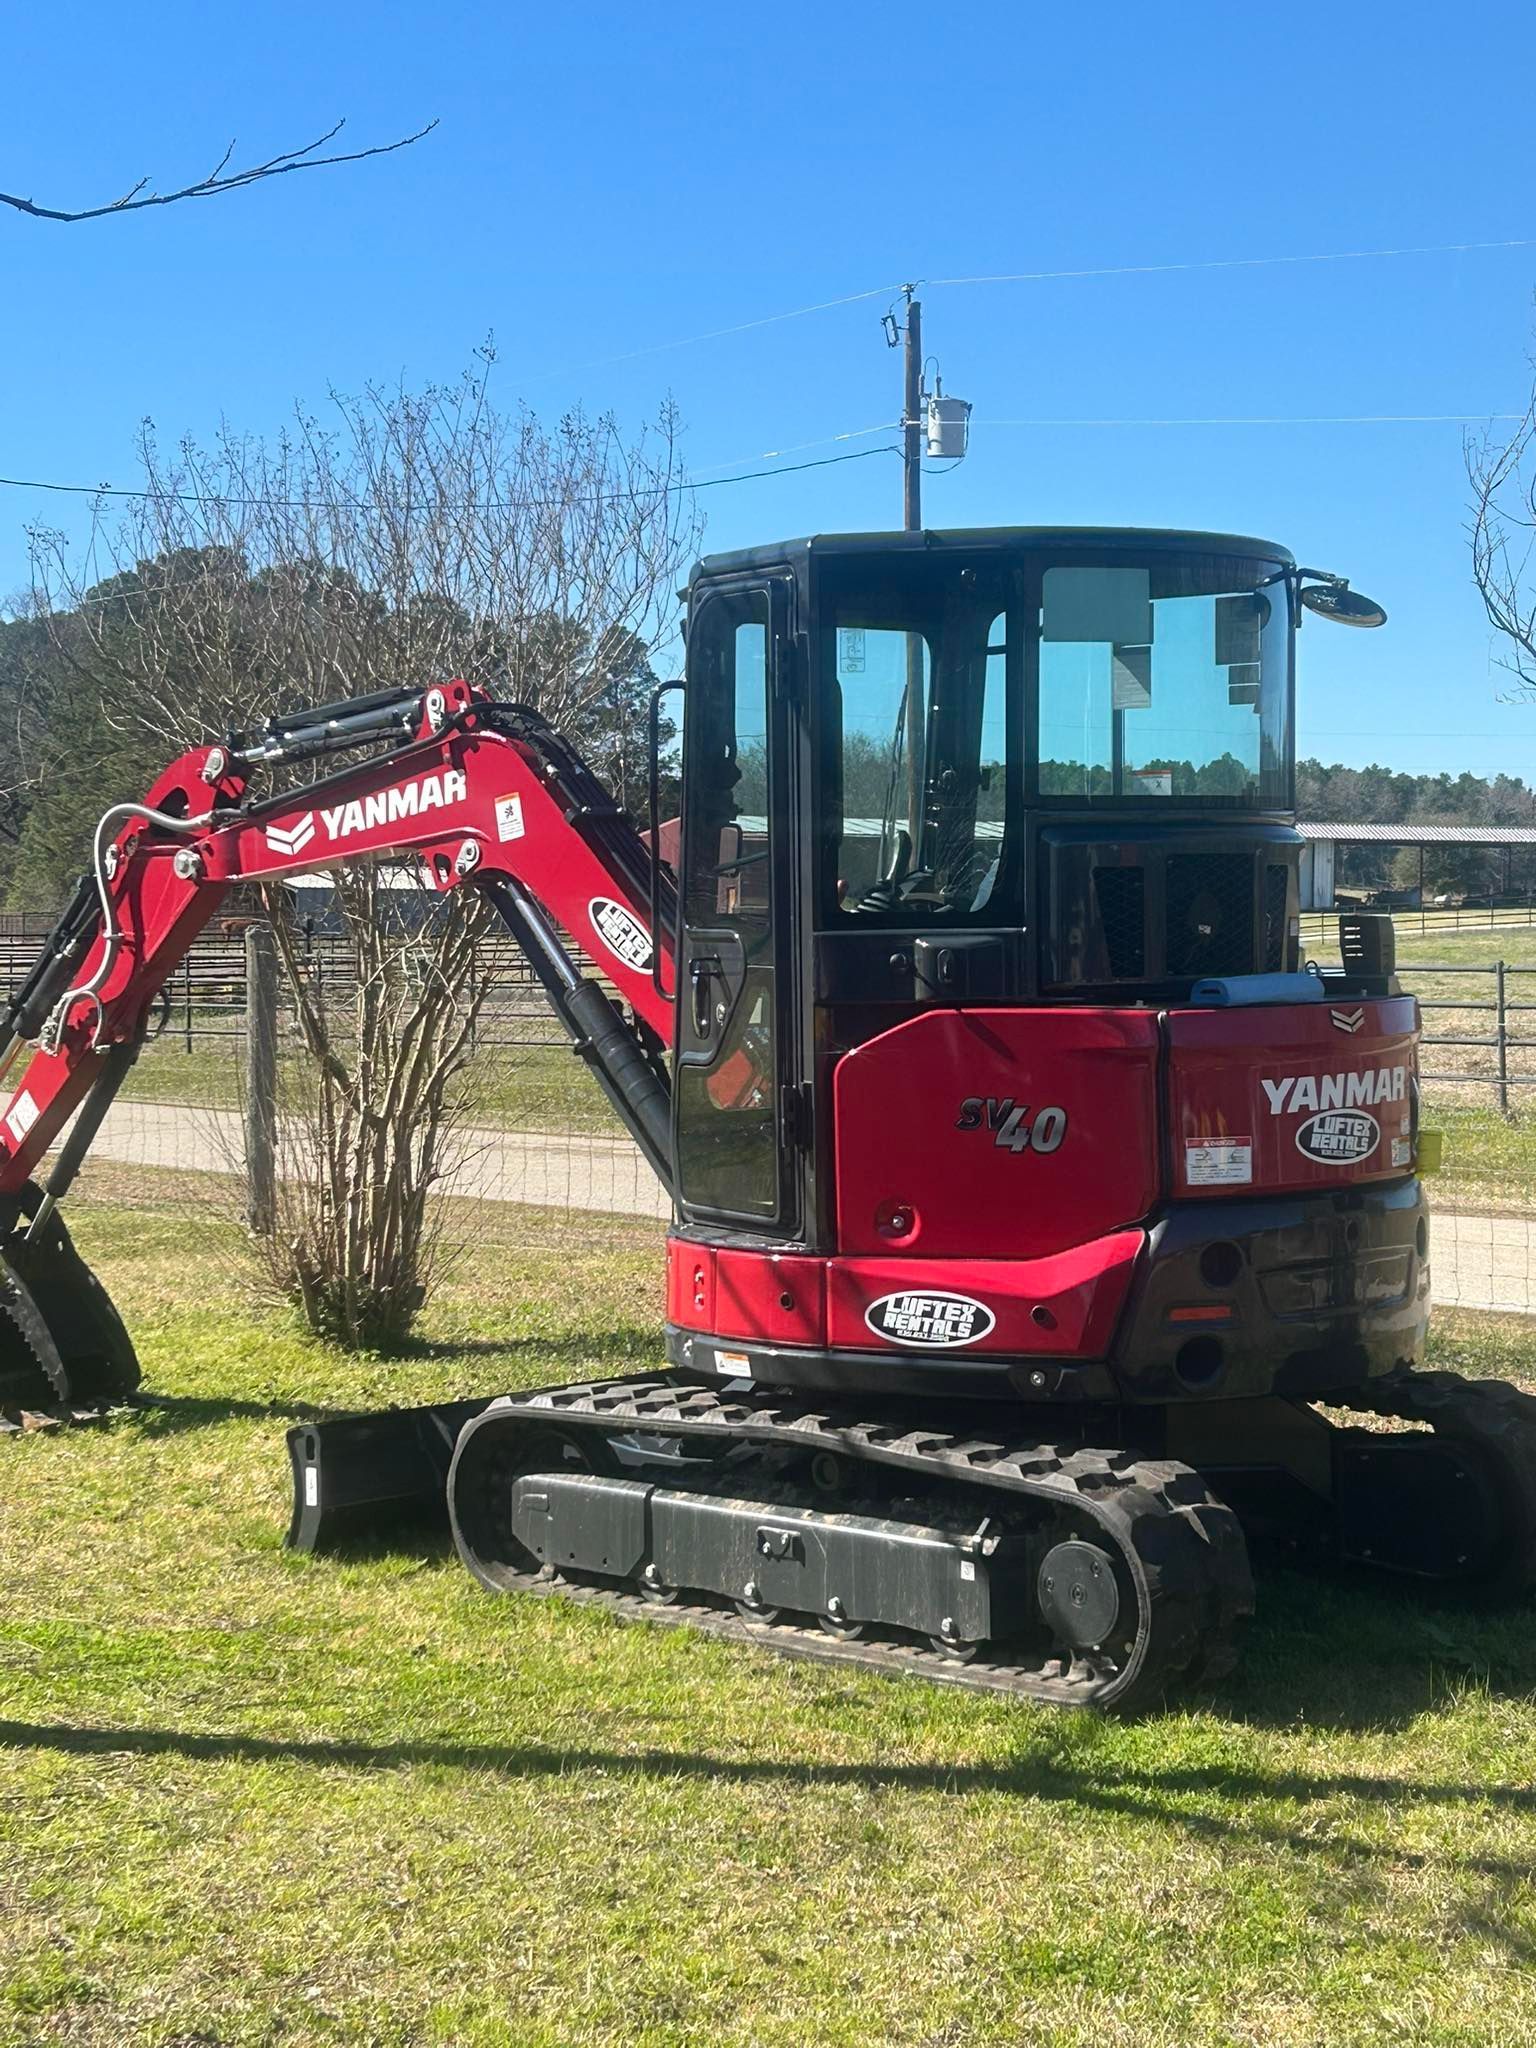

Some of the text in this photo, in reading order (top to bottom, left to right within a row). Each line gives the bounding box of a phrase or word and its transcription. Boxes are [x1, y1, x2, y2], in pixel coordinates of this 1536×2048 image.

[320, 770, 467, 841] YANMAR
[1261, 1066, 1405, 1115] YANMAR
[1312, 1116, 1371, 1137] LUFTEX
[1310, 1133, 1369, 1151] RENTALS
[885, 1296, 976, 1323] LUFTEX
[882, 1312, 972, 1338] RENTALS
